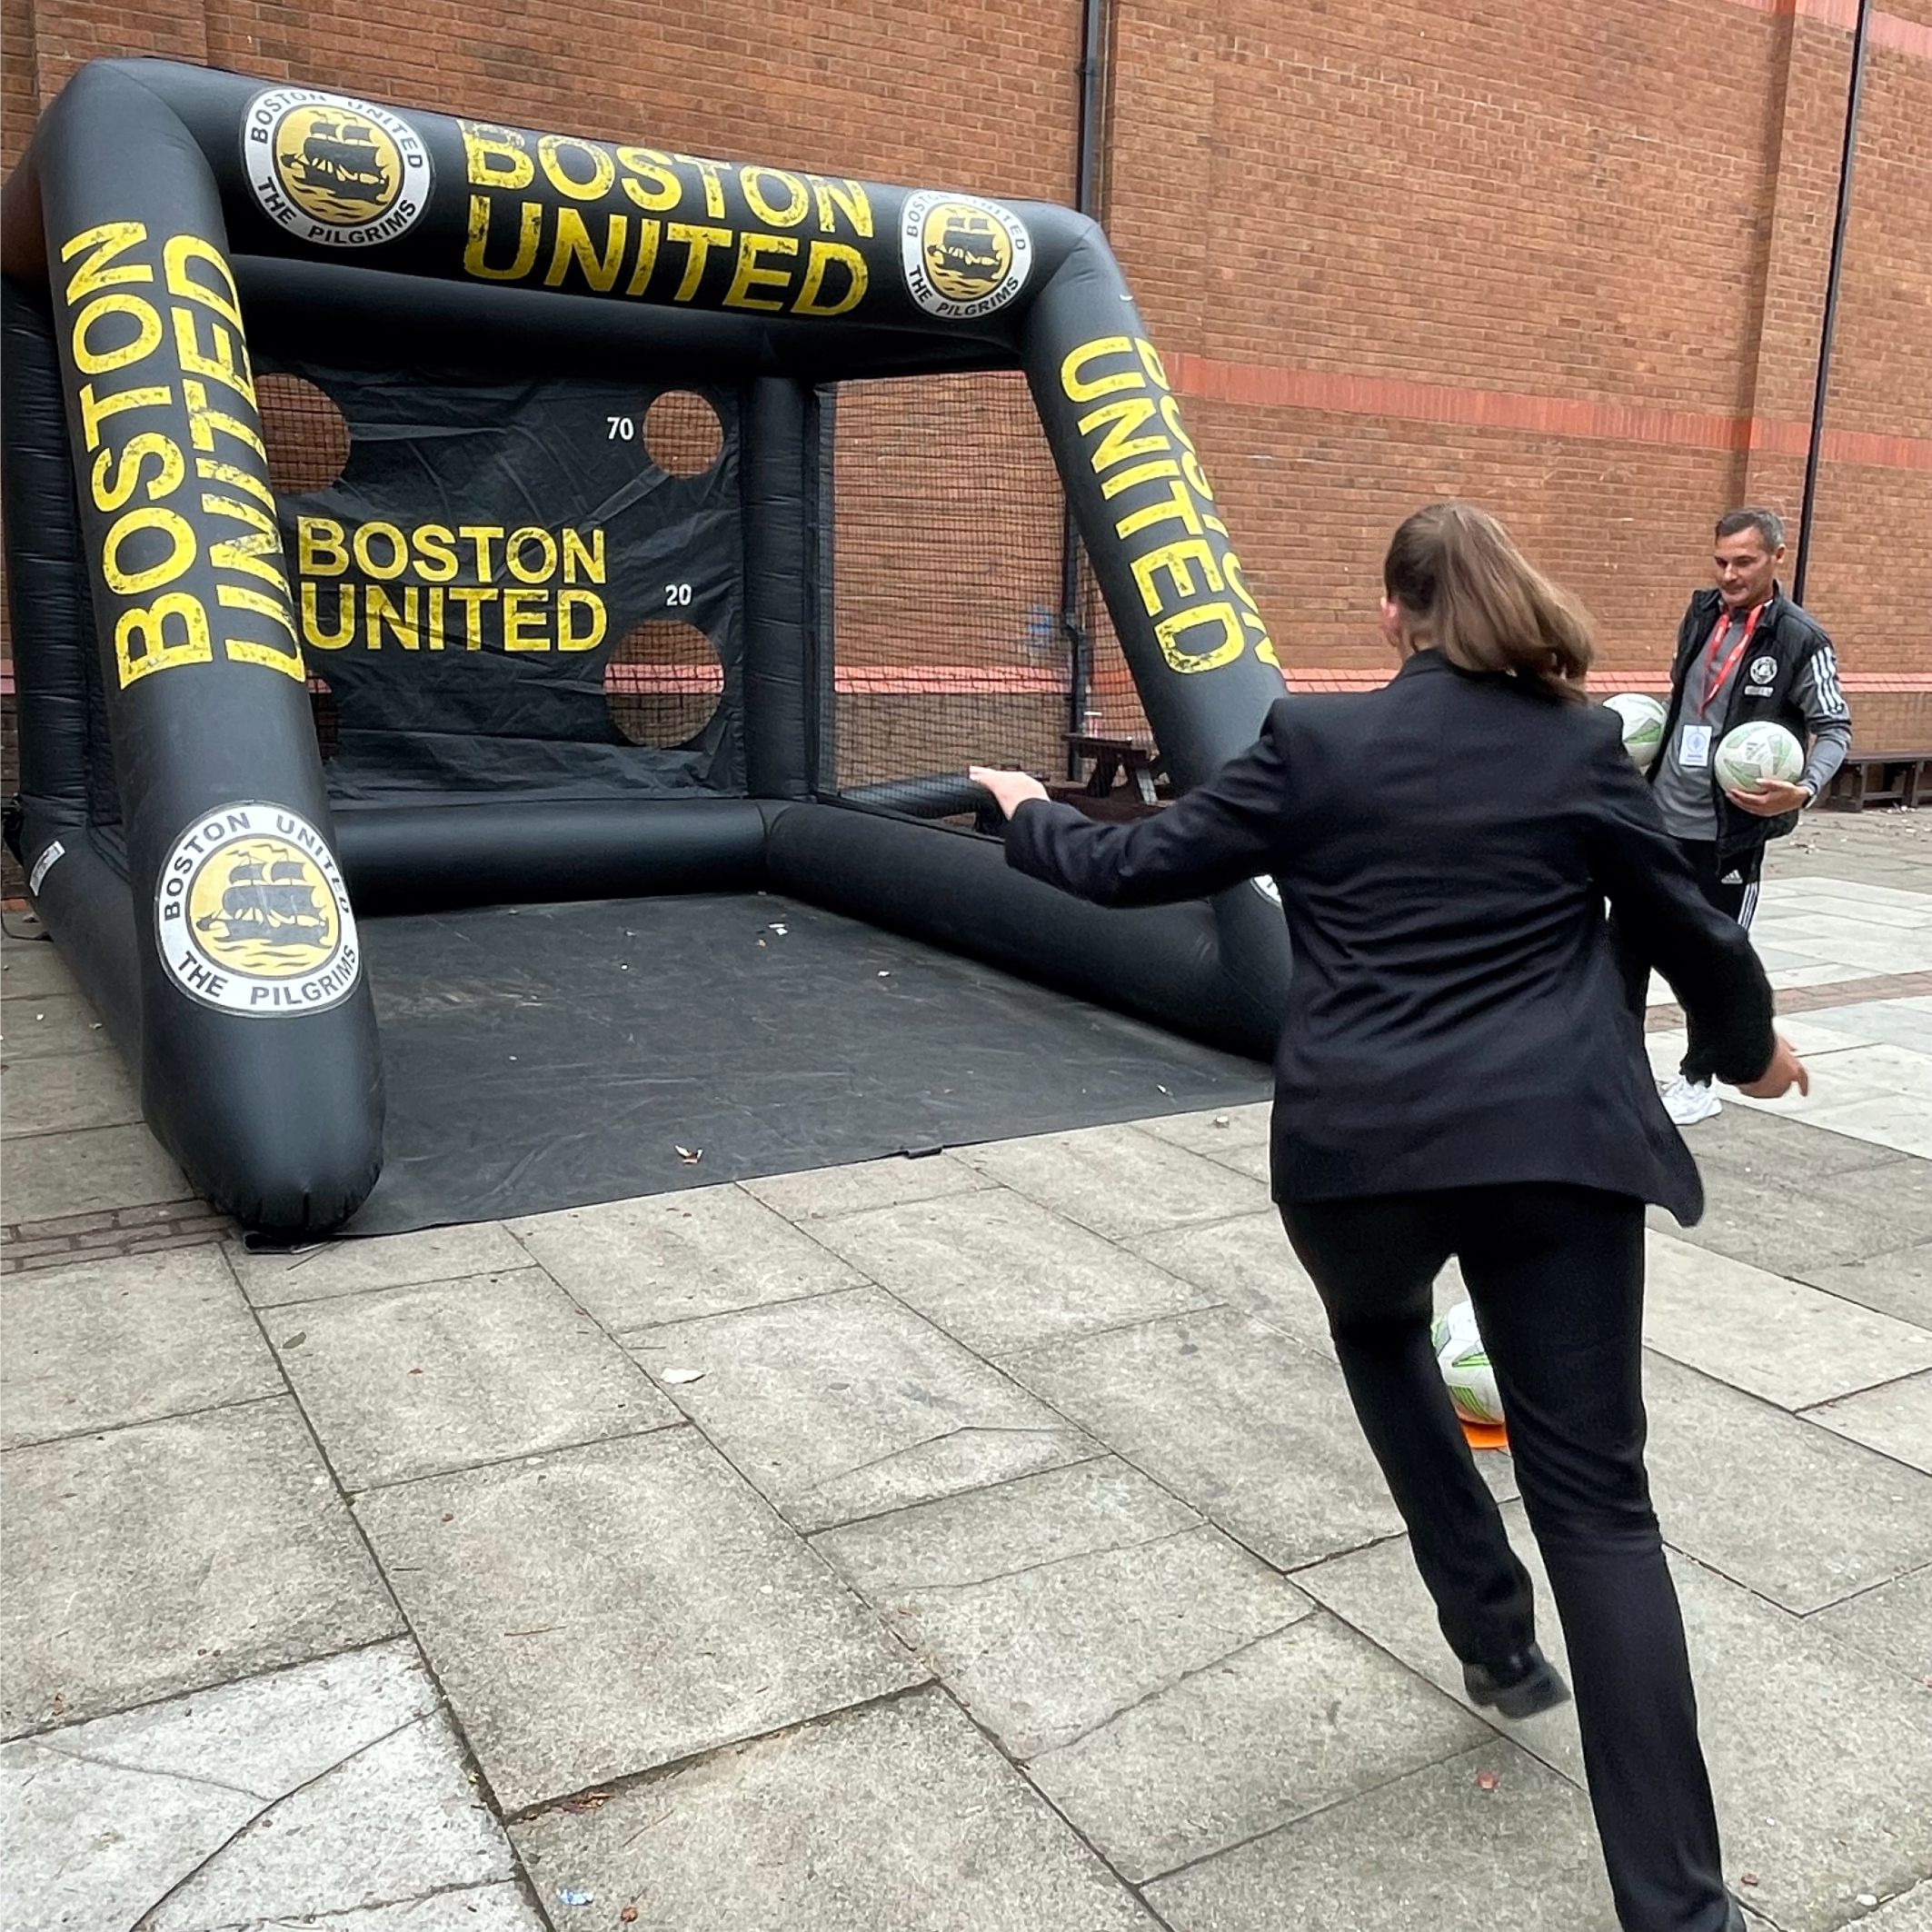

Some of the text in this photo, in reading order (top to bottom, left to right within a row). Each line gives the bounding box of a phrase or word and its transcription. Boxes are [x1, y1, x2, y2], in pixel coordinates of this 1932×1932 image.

[251, 91, 423, 169] BOSTON UNITED
[258, 175, 417, 244] THE PILGRIMS
[457, 118, 874, 238] BOSTON
[463, 194, 870, 317] UNITED
[909, 264, 1019, 316] THE PILGRIMS
[60, 220, 214, 691] BOSTON
[163, 234, 306, 682] UNITED
[606, 416, 634, 441] 70
[1061, 335, 1246, 674] UNITED
[296, 515, 607, 584] BOSTON
[300, 582, 608, 652] UNITED
[664, 583, 692, 606] 20
[164, 812, 251, 921] BOSTON
[275, 813, 350, 914] UNITED
[177, 944, 356, 1006] THE PILGRIMS
